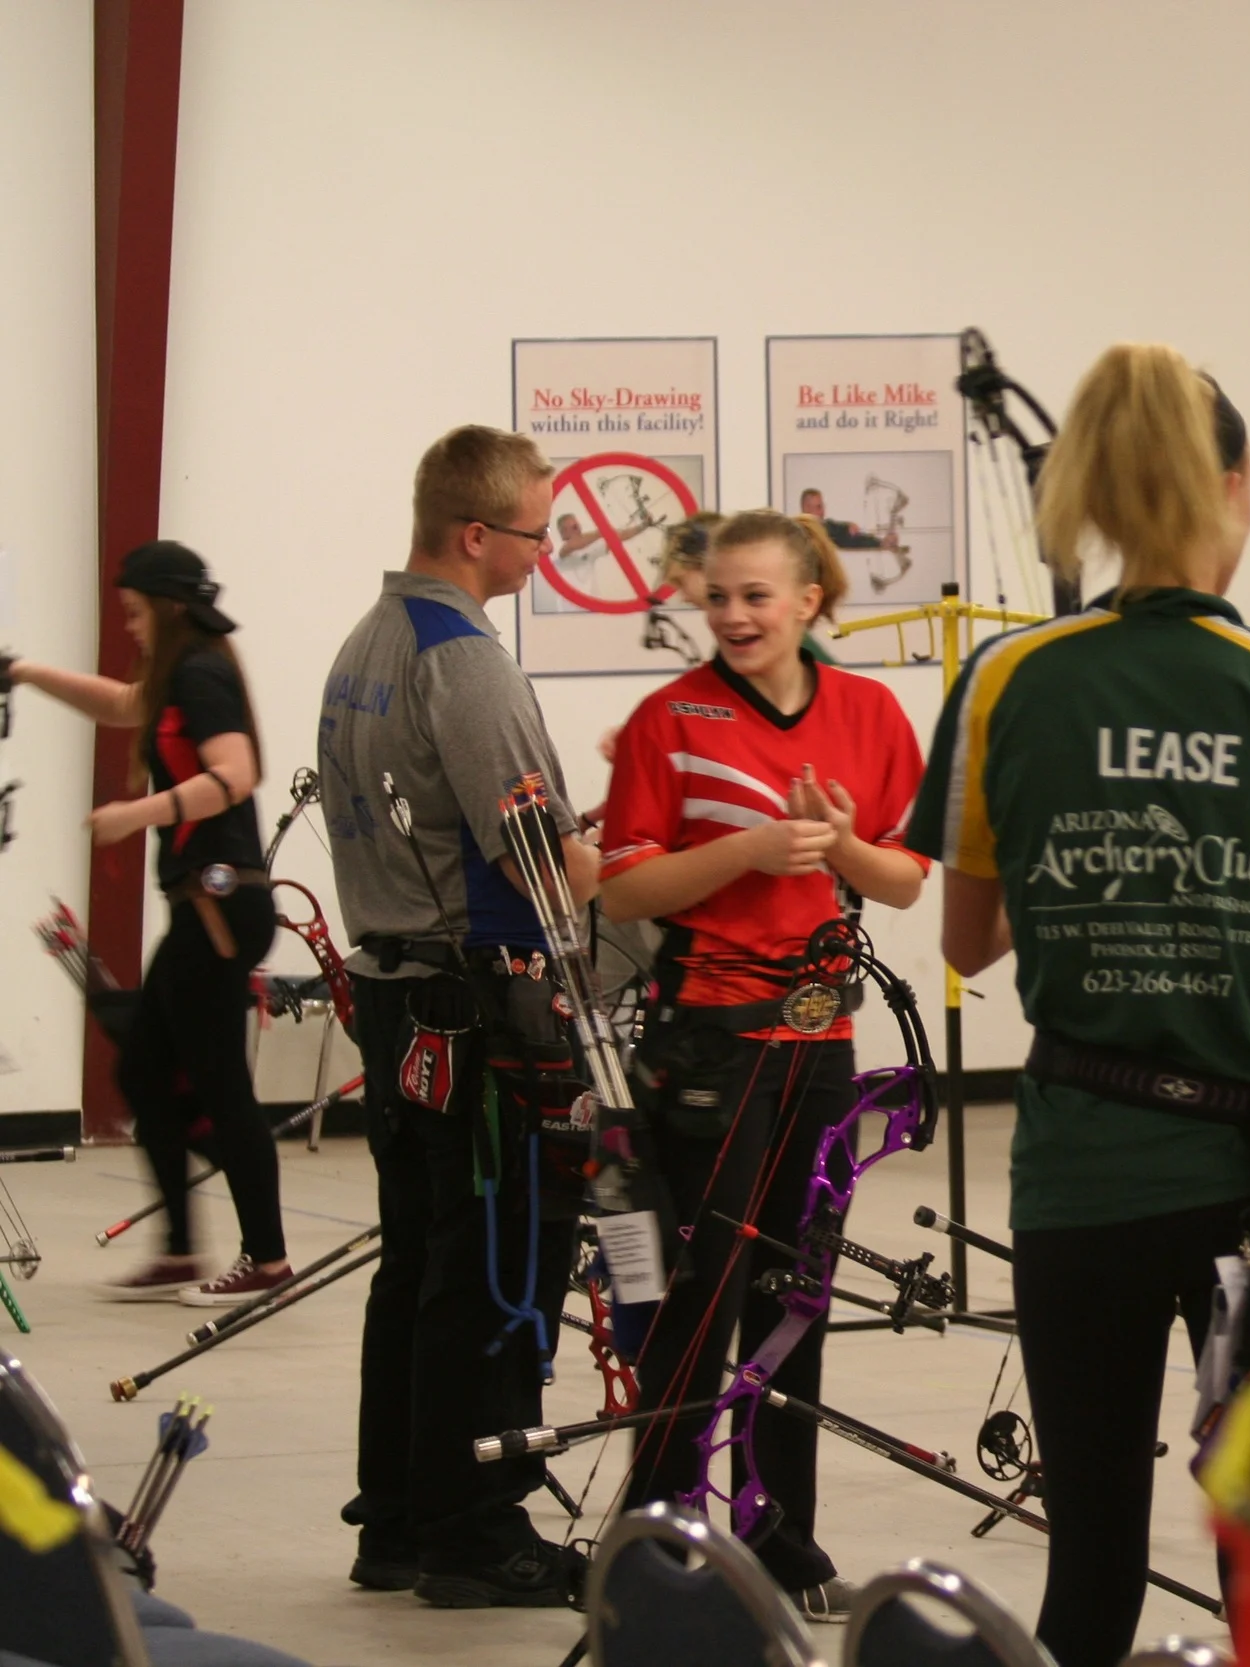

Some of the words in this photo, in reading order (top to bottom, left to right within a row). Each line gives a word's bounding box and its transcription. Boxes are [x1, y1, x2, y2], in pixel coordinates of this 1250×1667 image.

[532, 387, 563, 410] No
[570, 387, 703, 411] Sky-Drawing
[798, 384, 824, 406] Be
[832, 384, 876, 406] Like
[884, 384, 936, 405] Mike
[531, 413, 589, 432] within
[598, 412, 631, 432] this
[636, 411, 705, 433] facility!
[796, 413, 829, 430] and
[835, 412, 859, 429] do
[864, 412, 879, 429] it
[886, 410, 939, 432] Right!
[1098, 726, 1242, 787] LEASE
[1051, 809, 1152, 833] ARIZONA
[1027, 832, 1194, 892] Archery
[417, 1049, 435, 1103] HOYT
